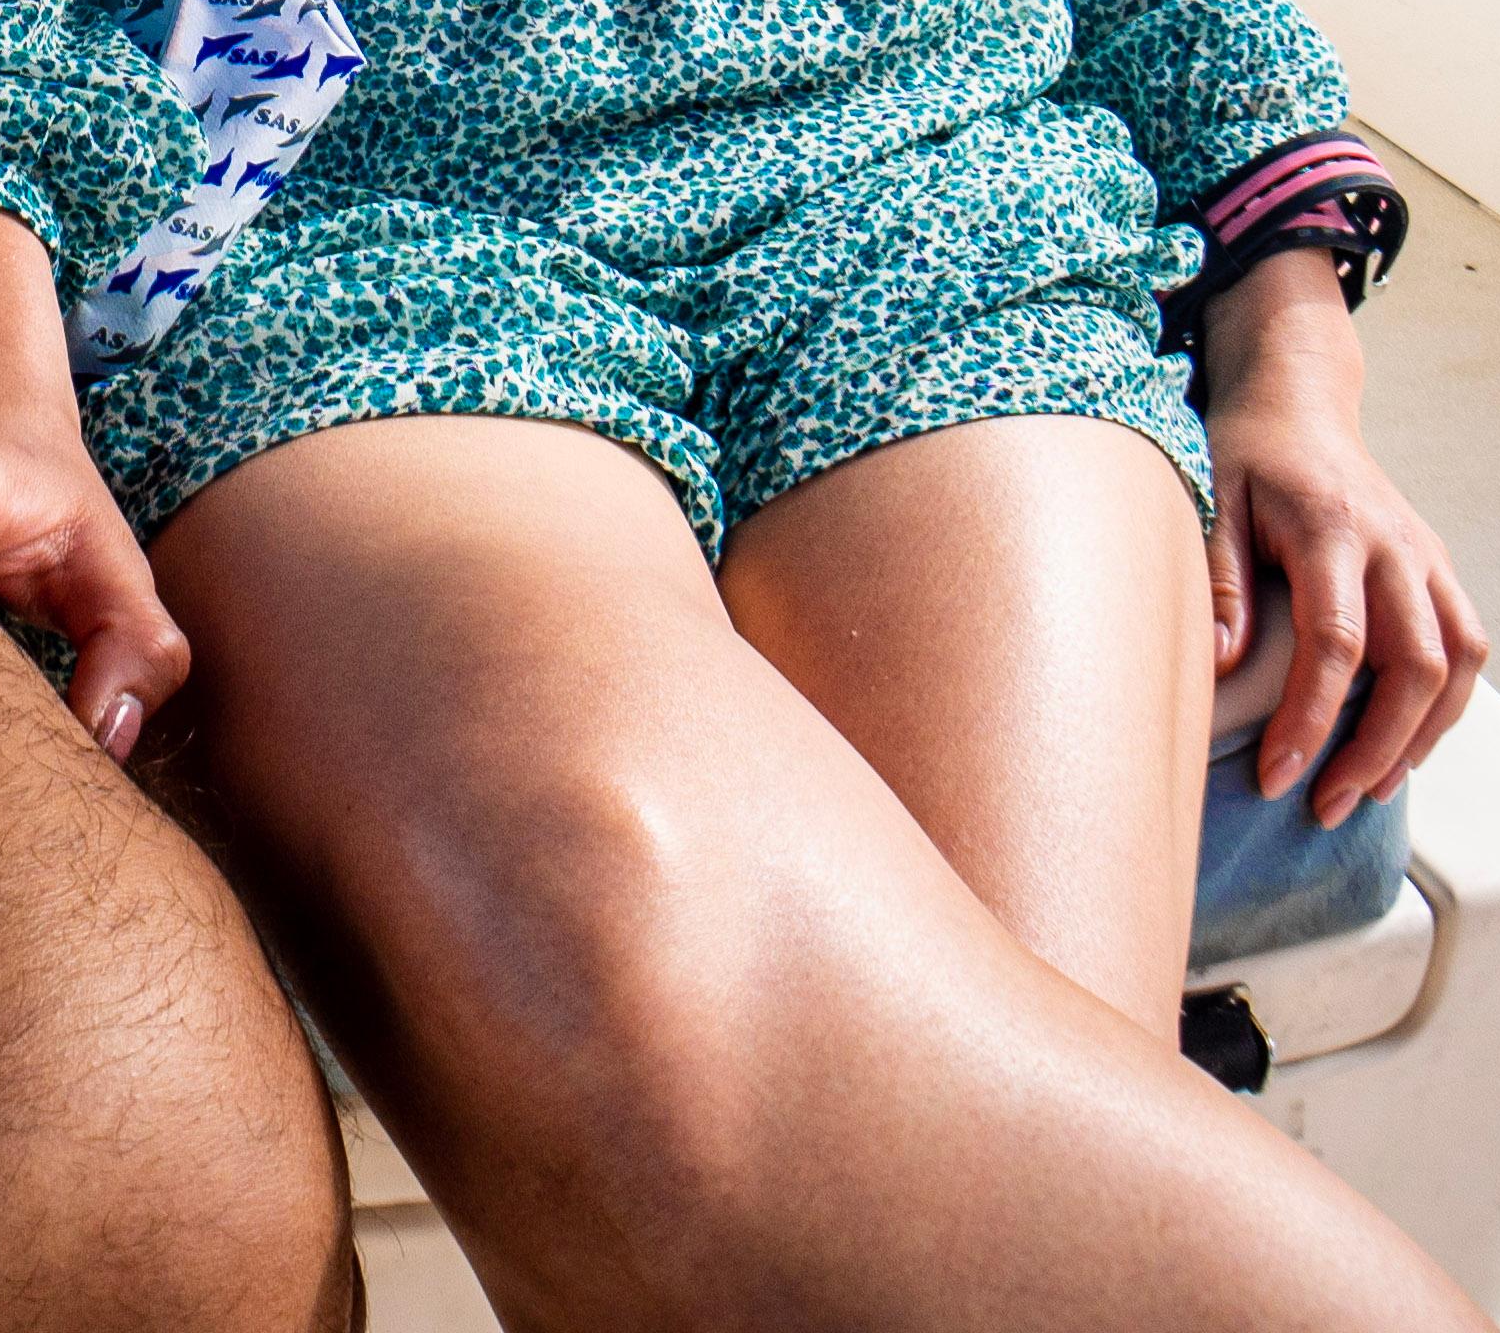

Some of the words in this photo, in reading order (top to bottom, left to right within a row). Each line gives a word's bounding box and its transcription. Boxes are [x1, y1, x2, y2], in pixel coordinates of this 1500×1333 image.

[227, 47, 279, 65] SAS
[254, 108, 300, 134] SAS
[168, 217, 214, 241] SAS
